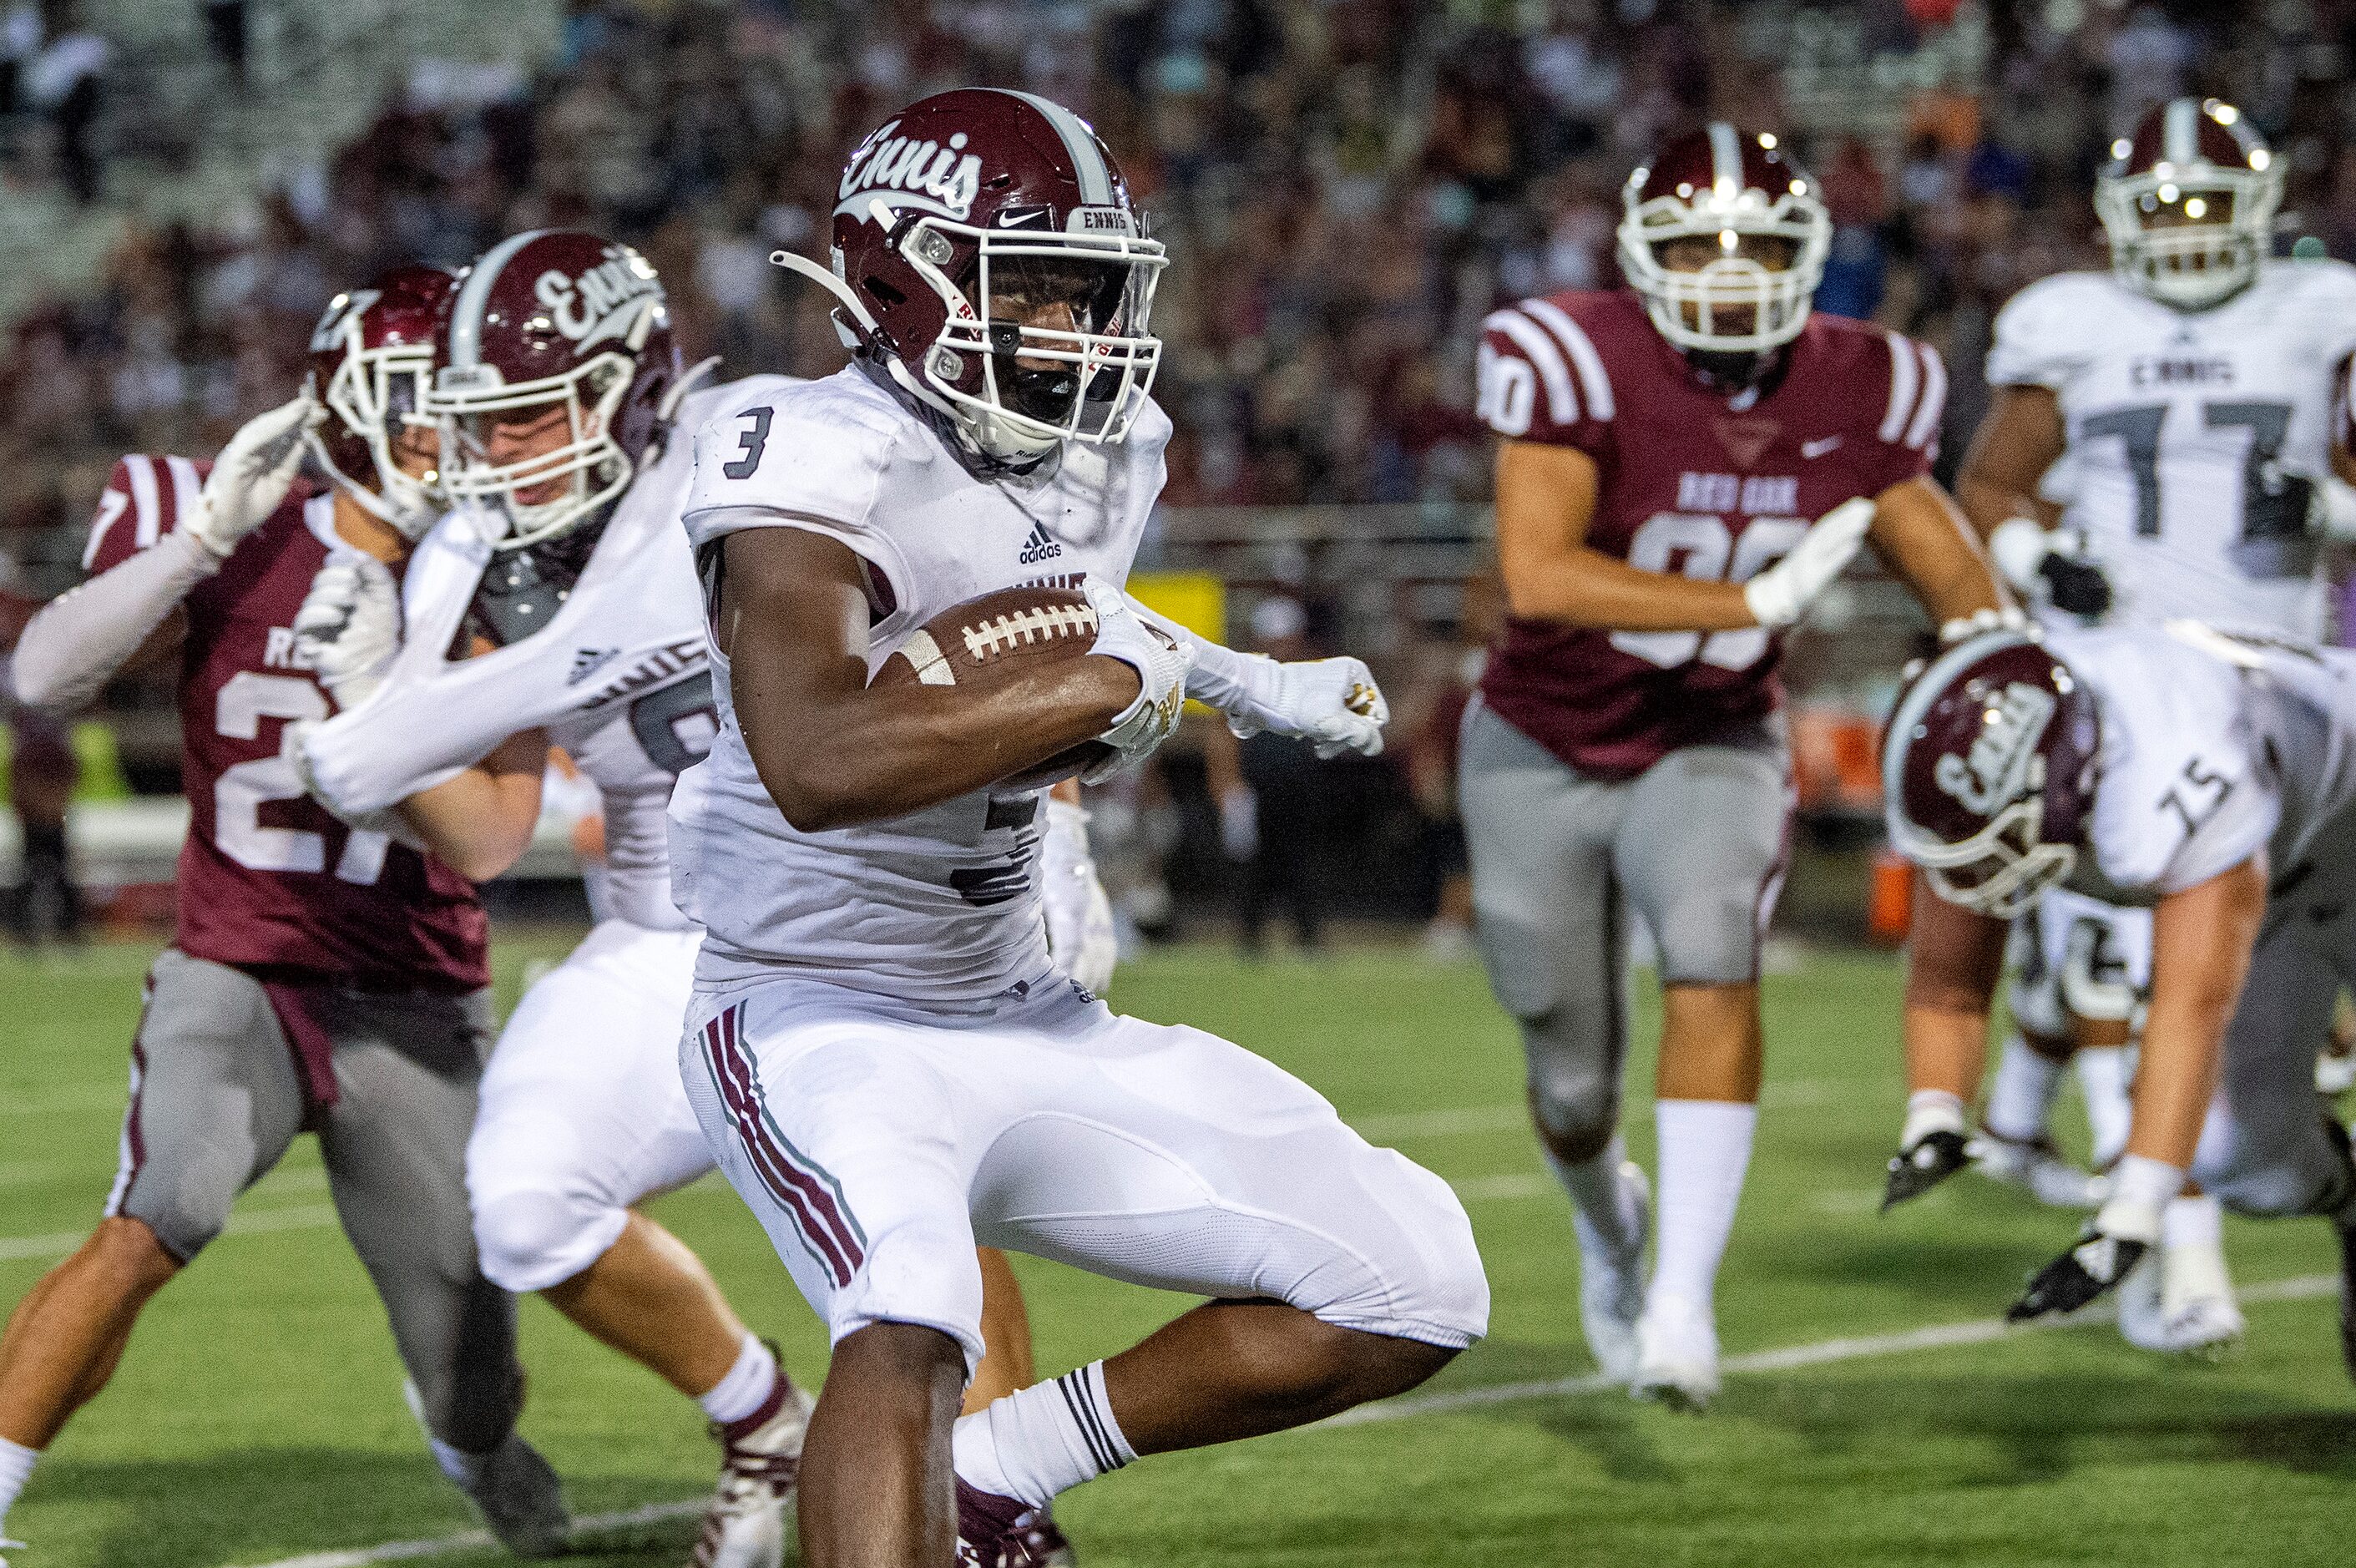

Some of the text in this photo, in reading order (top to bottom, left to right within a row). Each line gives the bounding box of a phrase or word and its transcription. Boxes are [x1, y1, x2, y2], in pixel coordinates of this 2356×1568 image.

[839, 119, 983, 209] Ennis
[1083, 211, 1126, 229] ENNIS
[723, 406, 775, 480] 3
[2081, 402, 2294, 541] 77
[1019, 544, 1062, 564] adidas
[2158, 758, 2233, 839] 75
